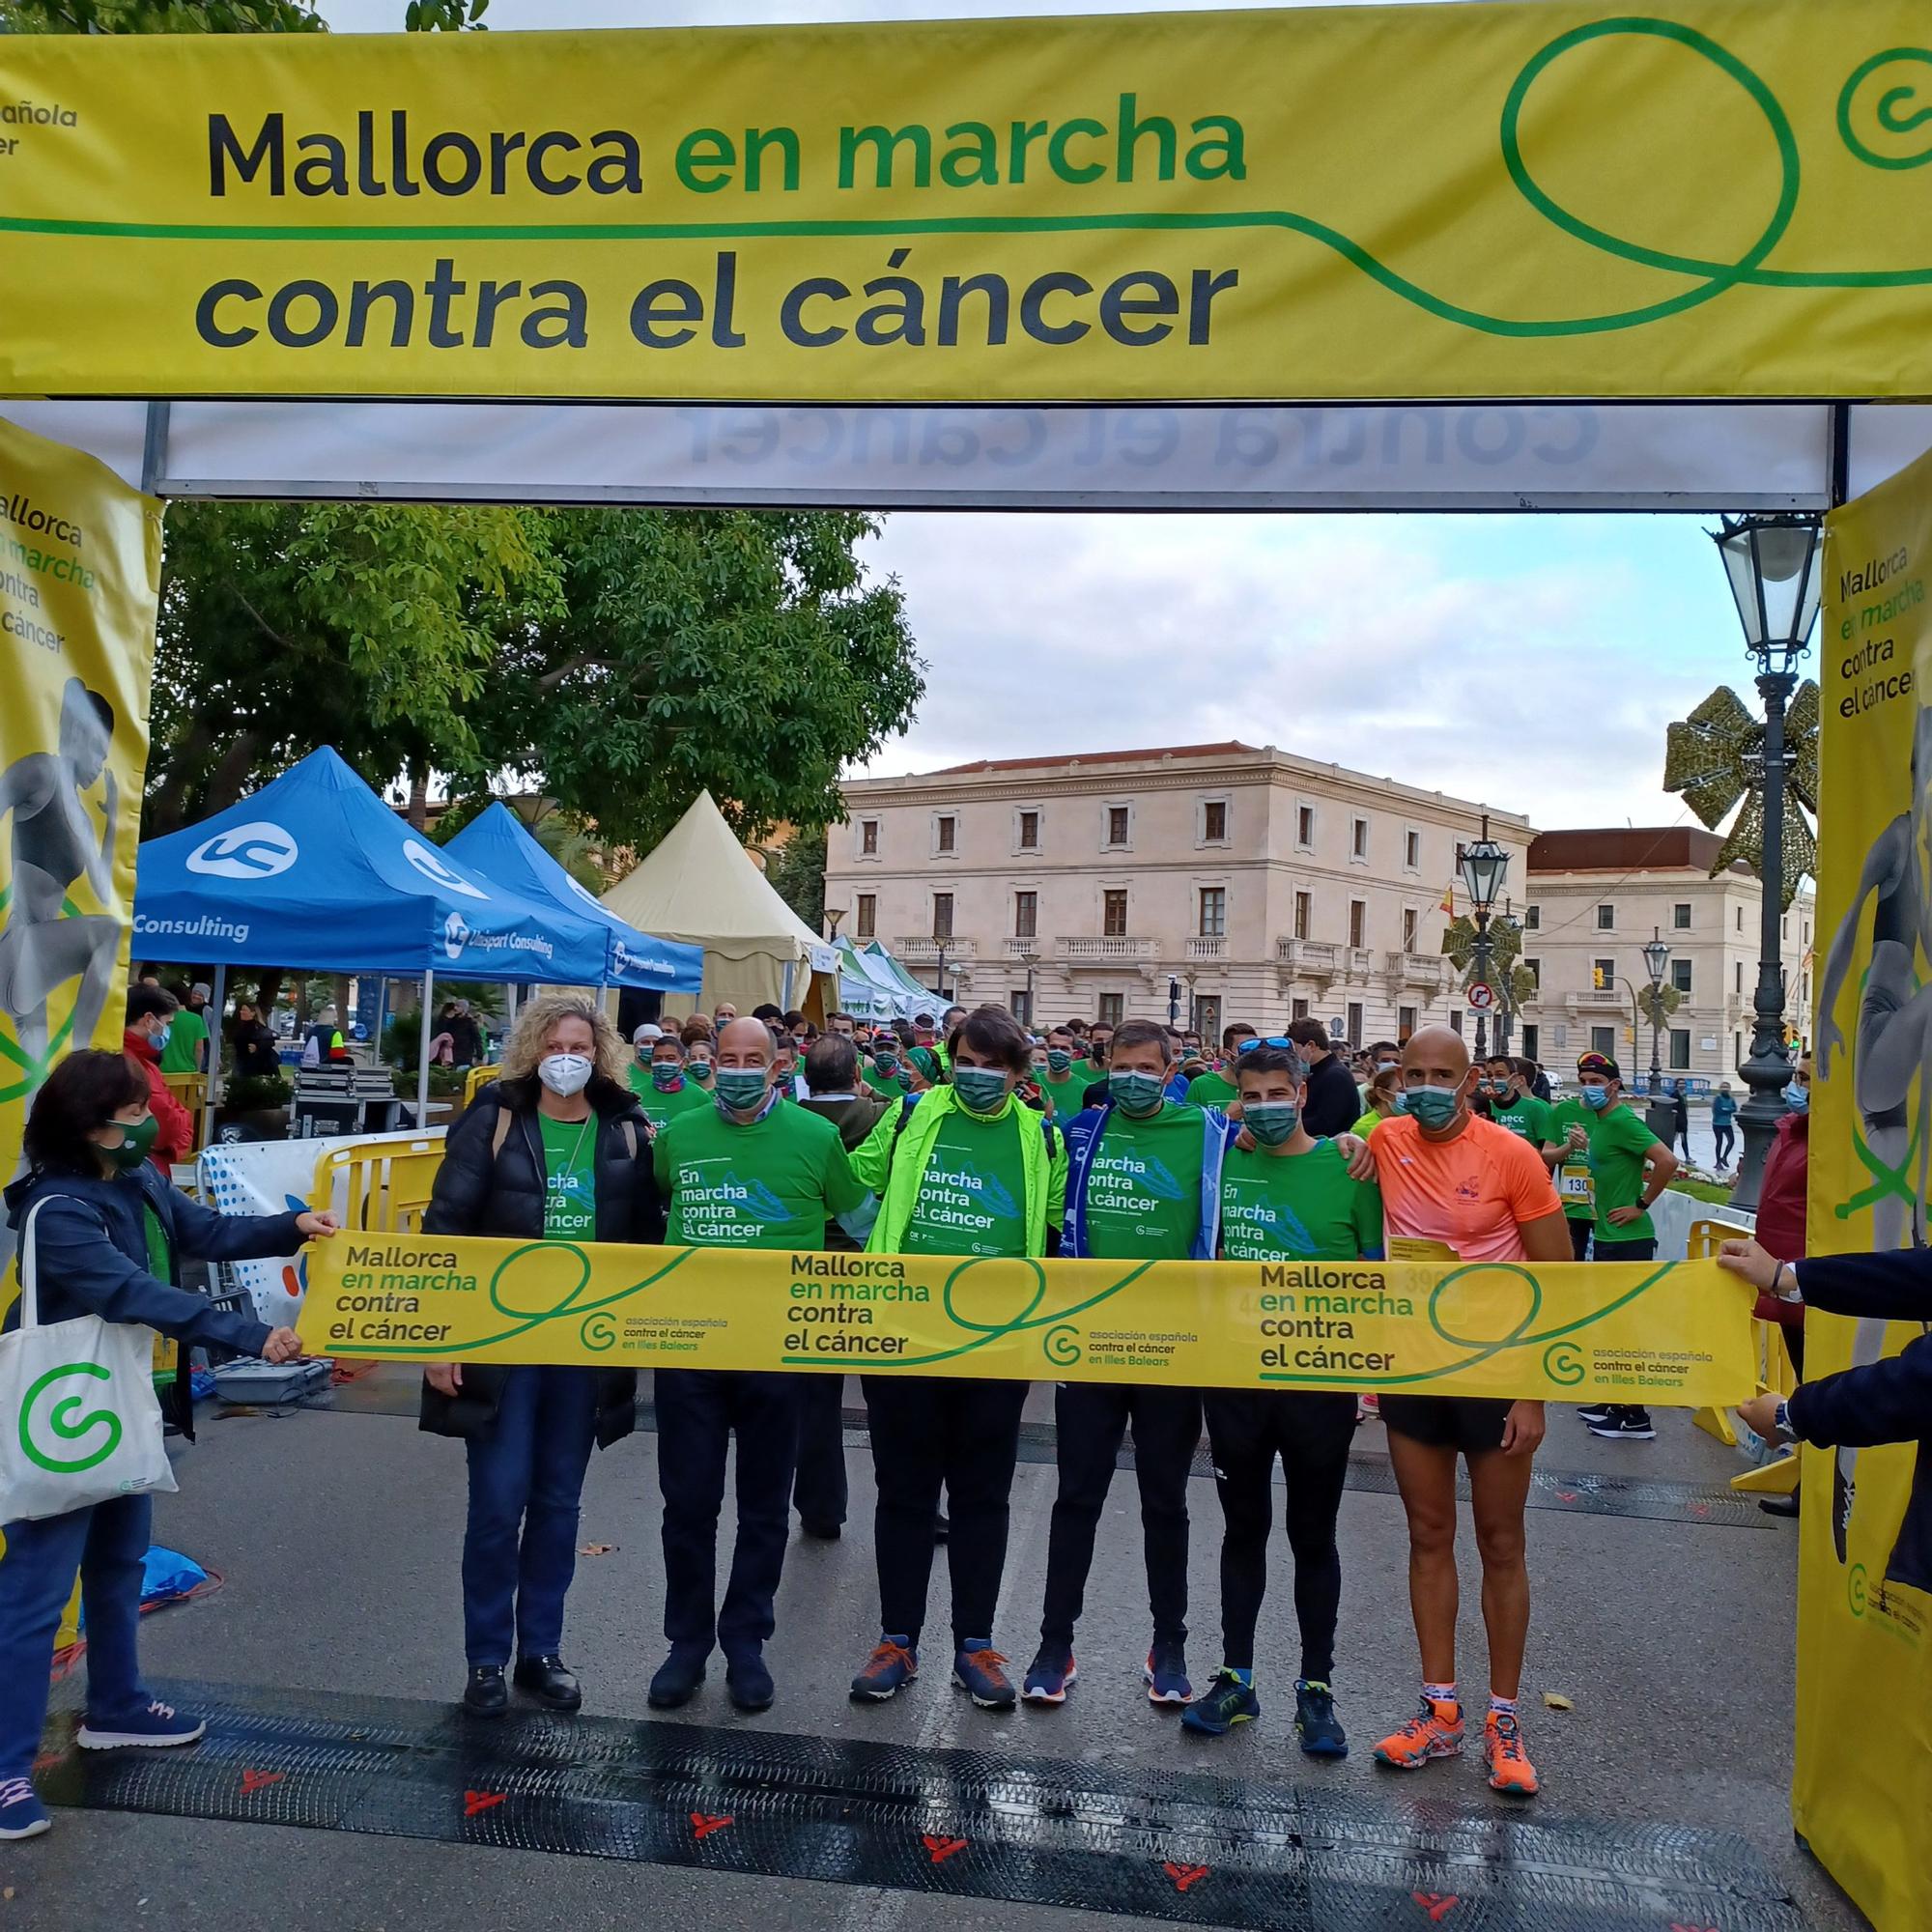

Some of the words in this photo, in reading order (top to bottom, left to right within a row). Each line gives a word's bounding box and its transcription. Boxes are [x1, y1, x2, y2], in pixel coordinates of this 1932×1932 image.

[208, 109, 643, 196] Mallorca
[675, 127, 800, 193] en
[838, 92, 1247, 189] marcha
[195, 258, 589, 349] contra
[629, 251, 746, 349] el
[780, 248, 1239, 348] cáncer
[1840, 547, 1907, 603] Mallorca
[1861, 579, 1925, 629] marcha
[2, 611, 66, 654] cáncer
[1841, 638, 1894, 679] contra
[1839, 687, 1861, 718] el
[132, 914, 249, 944] Consulting
[509, 930, 554, 960] Consulting
[1500, 1114, 1524, 1123] aecc
[679, 1169, 699, 1184] En
[681, 1182, 748, 1202] marcha
[920, 1187, 970, 1207] ontra
[1094, 1190, 1159, 1211] cáncer
[1224, 1183, 1237, 1199] En
[682, 1203, 736, 1219] contra
[912, 1202, 926, 1219] el
[929, 1206, 995, 1229] cáncer
[683, 1219, 696, 1235] el
[697, 1220, 765, 1236] cáncer
[346, 1246, 457, 1268] Mallorca
[1231, 1241, 1290, 1261] cáncer
[791, 1255, 905, 1278] Mallorca
[341, 1273, 373, 1289] en
[380, 1270, 477, 1291] marcha
[1261, 1265, 1386, 1290] Mallorca
[790, 1282, 822, 1299] en
[830, 1280, 930, 1302] marcha
[335, 1293, 419, 1313] contra
[787, 1303, 873, 1324] contra
[1260, 1293, 1295, 1312] en
[1305, 1292, 1413, 1316] marcha
[329, 1318, 355, 1340] el
[360, 1319, 452, 1341] cáncer
[626, 1317, 680, 1327] asociación
[681, 1319, 728, 1328] española
[1260, 1316, 1354, 1339] contra
[623, 1328, 657, 1338] contra
[659, 1328, 668, 1338] el
[669, 1328, 706, 1339] cáncer
[783, 1328, 809, 1351] el
[815, 1329, 909, 1353] cáncer
[1089, 1330, 1146, 1341] asociación
[1149, 1331, 1198, 1343] española
[622, 1341, 635, 1350] en
[660, 1341, 698, 1351] Balears
[1089, 1343, 1125, 1352] contra
[1126, 1343, 1136, 1352] el
[1138, 1344, 1176, 1354] cáncer
[1593, 1348, 1656, 1359] asociación
[1659, 1350, 1713, 1362] española
[1089, 1355, 1102, 1364] en
[1128, 1355, 1170, 1366] Balears
[1261, 1344, 1289, 1367] el
[1294, 1345, 1395, 1371] cáncer
[1594, 1361, 1633, 1372] contra
[1634, 1361, 1645, 1372] el
[1647, 1362, 1690, 1374] cáncer
[1594, 1375, 1609, 1384] en
[1638, 1375, 1684, 1387] Balears
